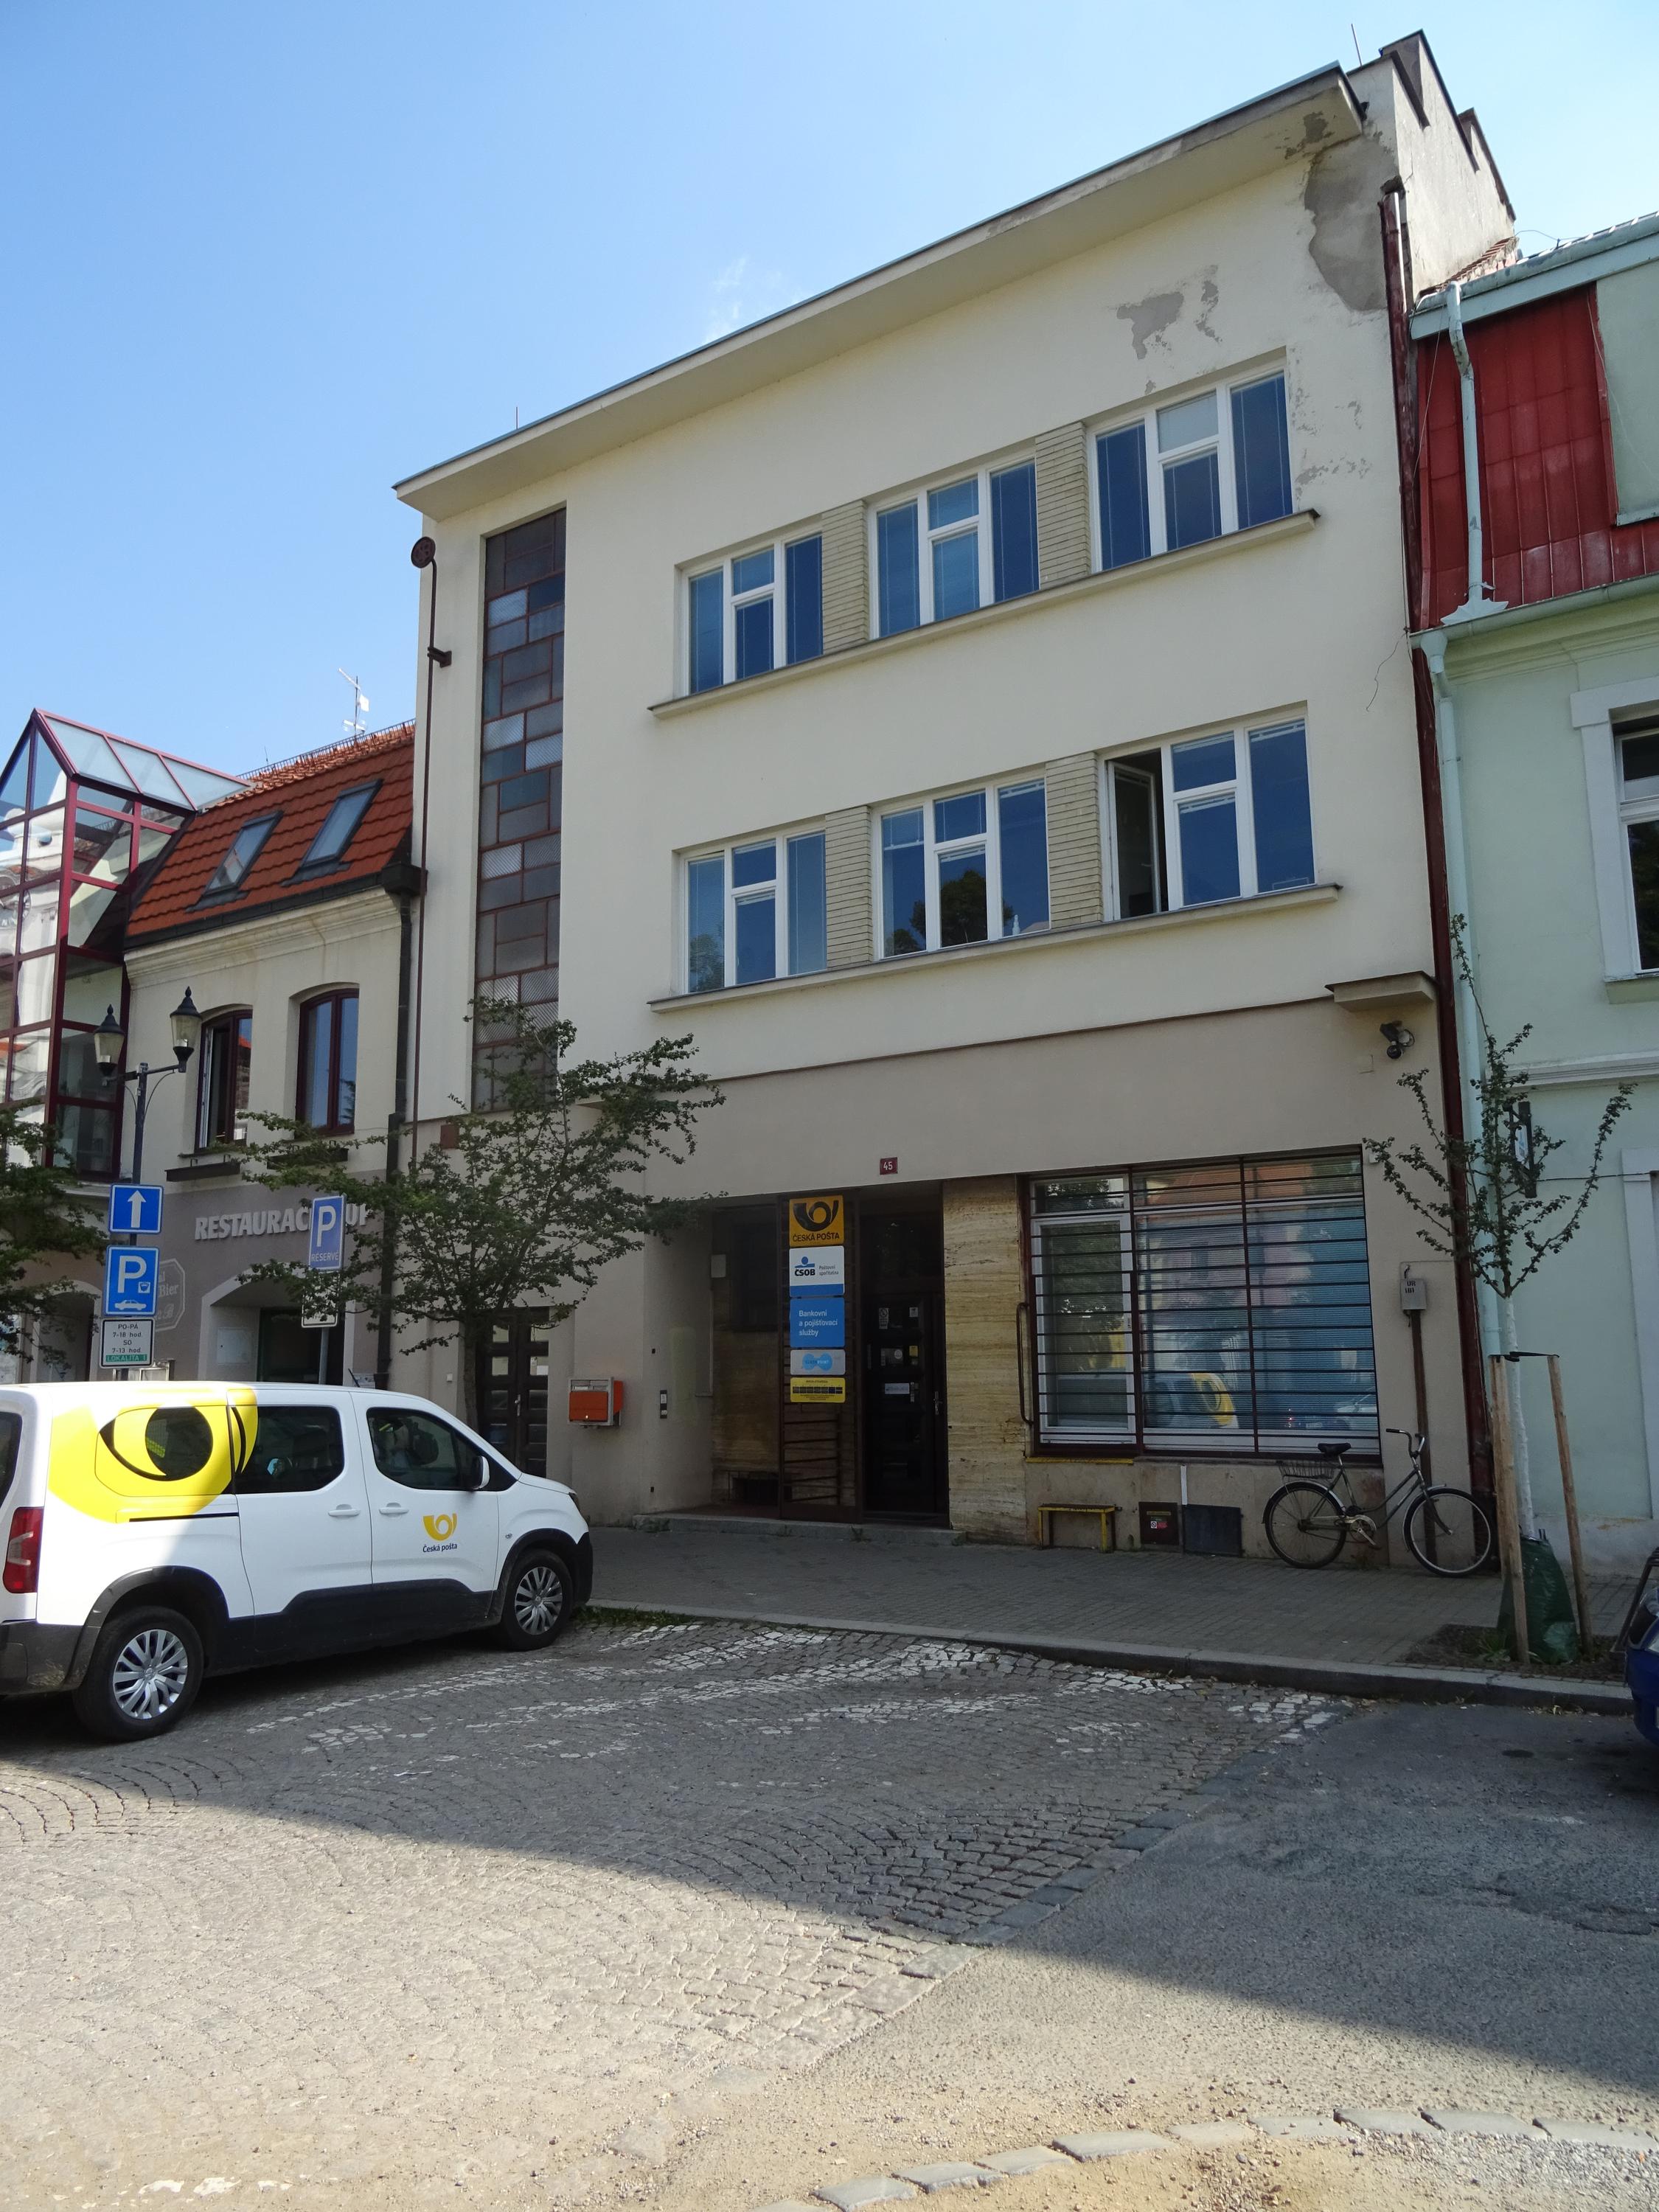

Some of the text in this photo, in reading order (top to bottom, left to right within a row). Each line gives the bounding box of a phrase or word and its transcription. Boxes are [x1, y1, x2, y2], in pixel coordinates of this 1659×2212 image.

[883, 1161, 893, 1170] 45
[195, 1206, 312, 1239] RESTAURAC
[317, 1206, 335, 1247] P
[793, 1231, 840, 1242] ČESKÁ POŠTA
[118, 1256, 147, 1293] P
[794, 1267, 815, 1276] ČSOB
[799, 1329, 818, 1338] služby
[423, 1543, 457, 1552] Česká pošta
